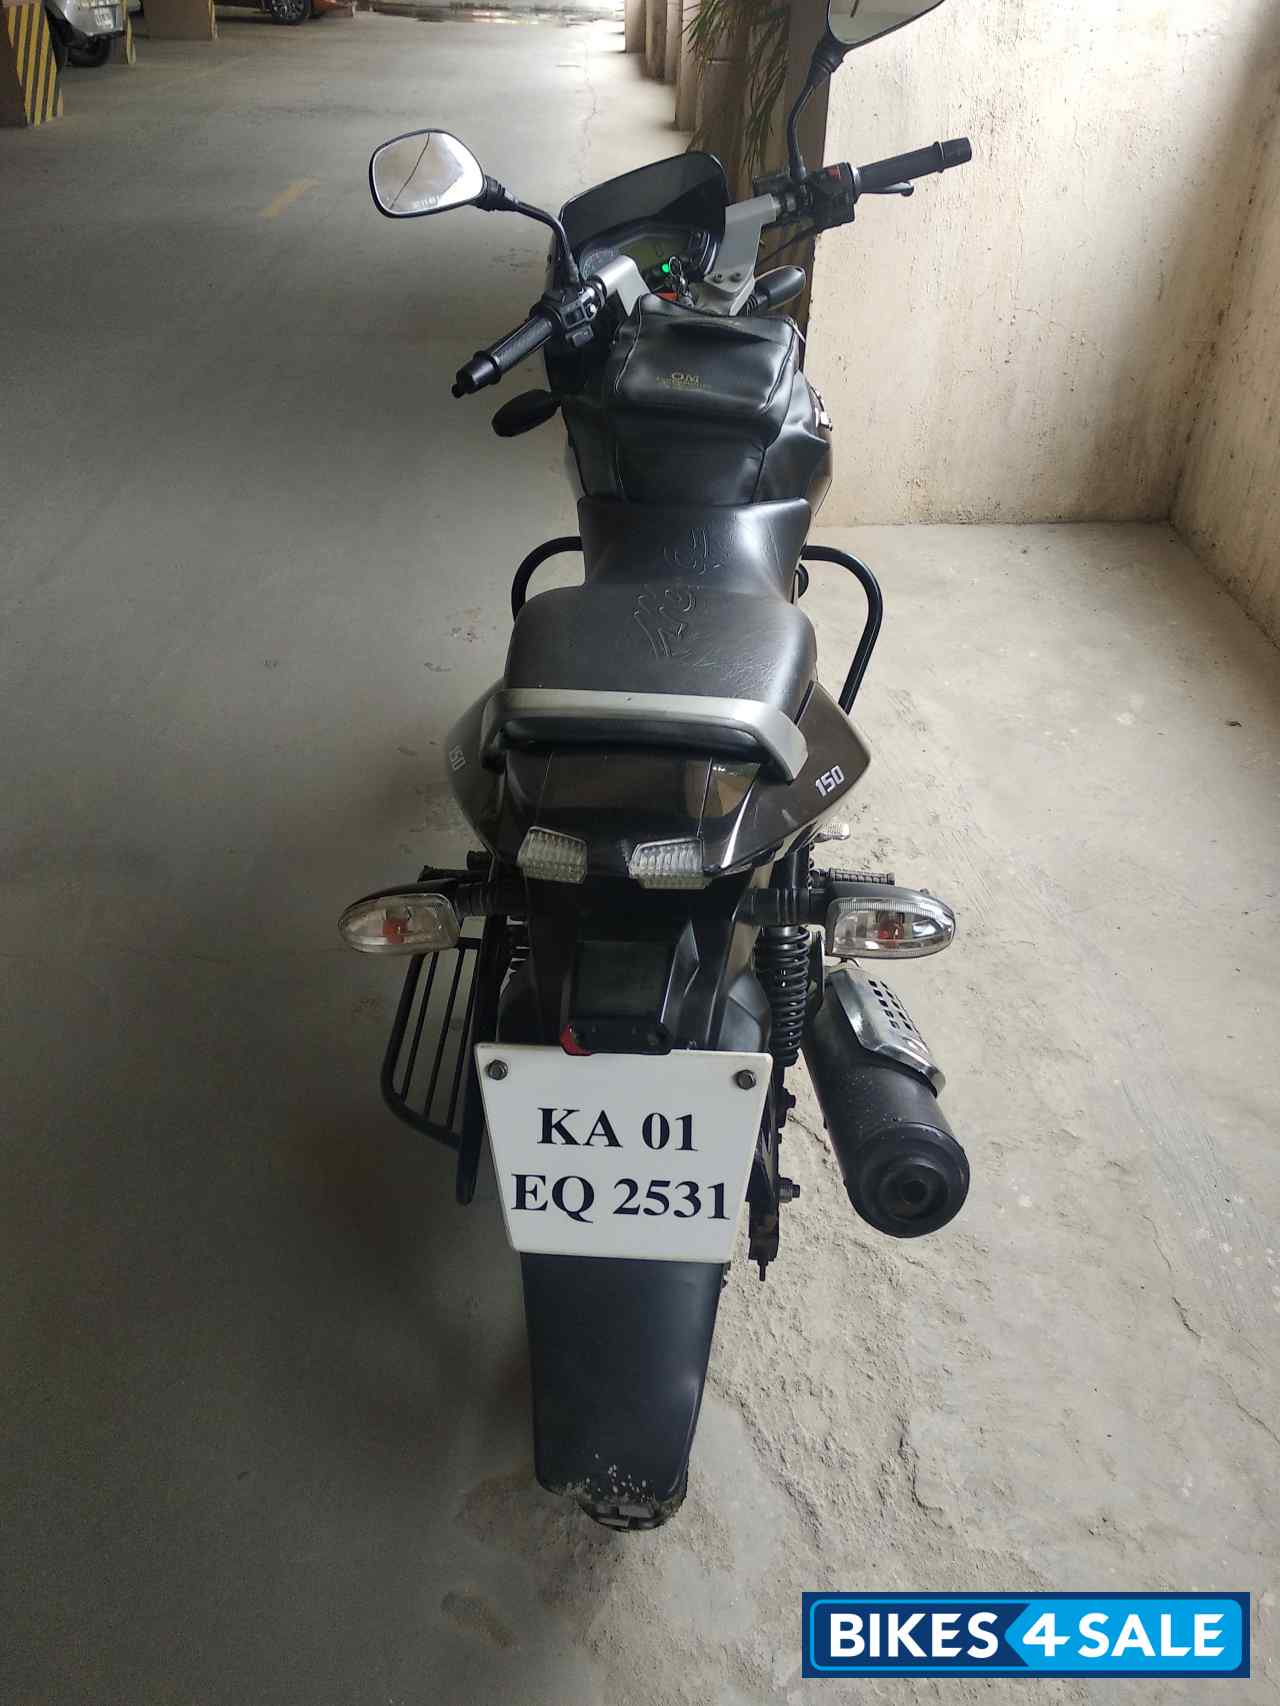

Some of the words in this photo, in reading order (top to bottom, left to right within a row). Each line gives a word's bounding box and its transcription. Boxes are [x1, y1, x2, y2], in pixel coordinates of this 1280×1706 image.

[815, 765, 845, 797] 150
[538, 1107, 623, 1148] KA
[642, 1113, 699, 1152] 01
[510, 1173, 595, 1224] EQ
[613, 1178, 731, 1221] 2531
